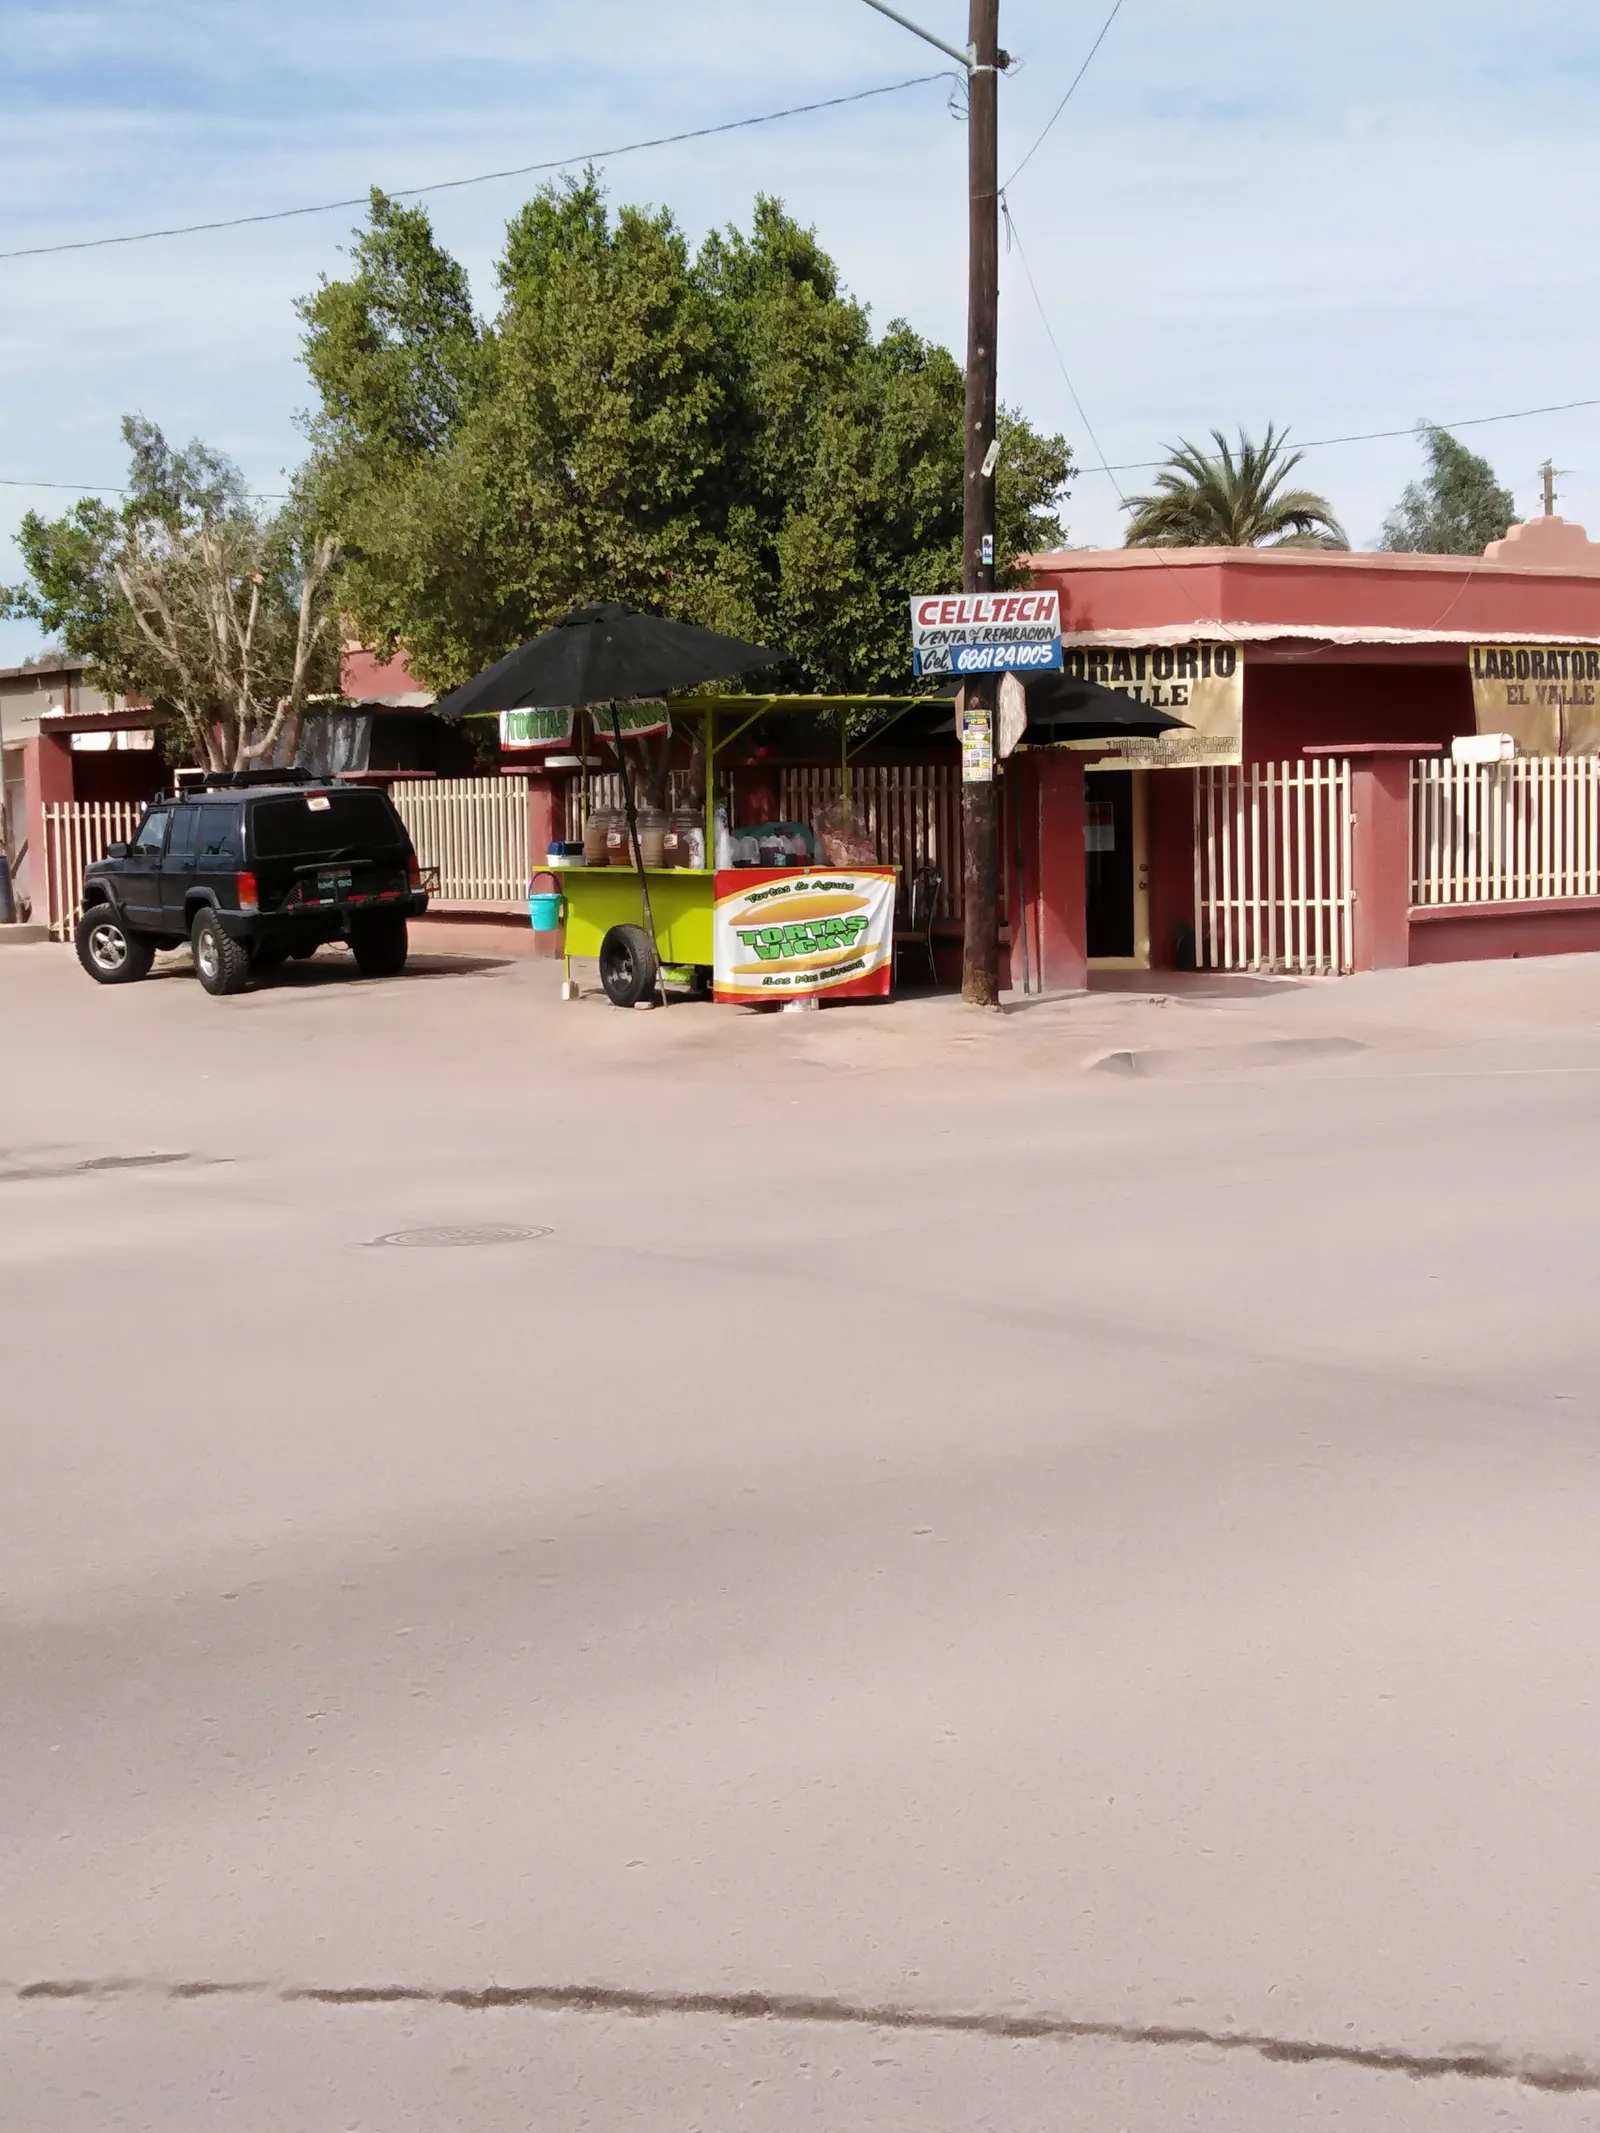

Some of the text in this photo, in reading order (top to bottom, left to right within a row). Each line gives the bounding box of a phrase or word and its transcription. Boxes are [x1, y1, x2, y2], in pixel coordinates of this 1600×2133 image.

[918, 596, 1056, 626] CELLTECH
[919, 629, 967, 646] VENTA
[983, 626, 1056, 642] REPARACION
[923, 645, 1054, 670] Cel. 6861241005
[1473, 648, 1600, 681] LABORATOR
[1507, 684, 1595, 705] EL VALLE
[507, 709, 568, 740] TORTAS
[744, 880, 855, 904] Tortas & Aguas
[736, 915, 869, 946] TORTAS
[754, 930, 860, 961] VICKY
